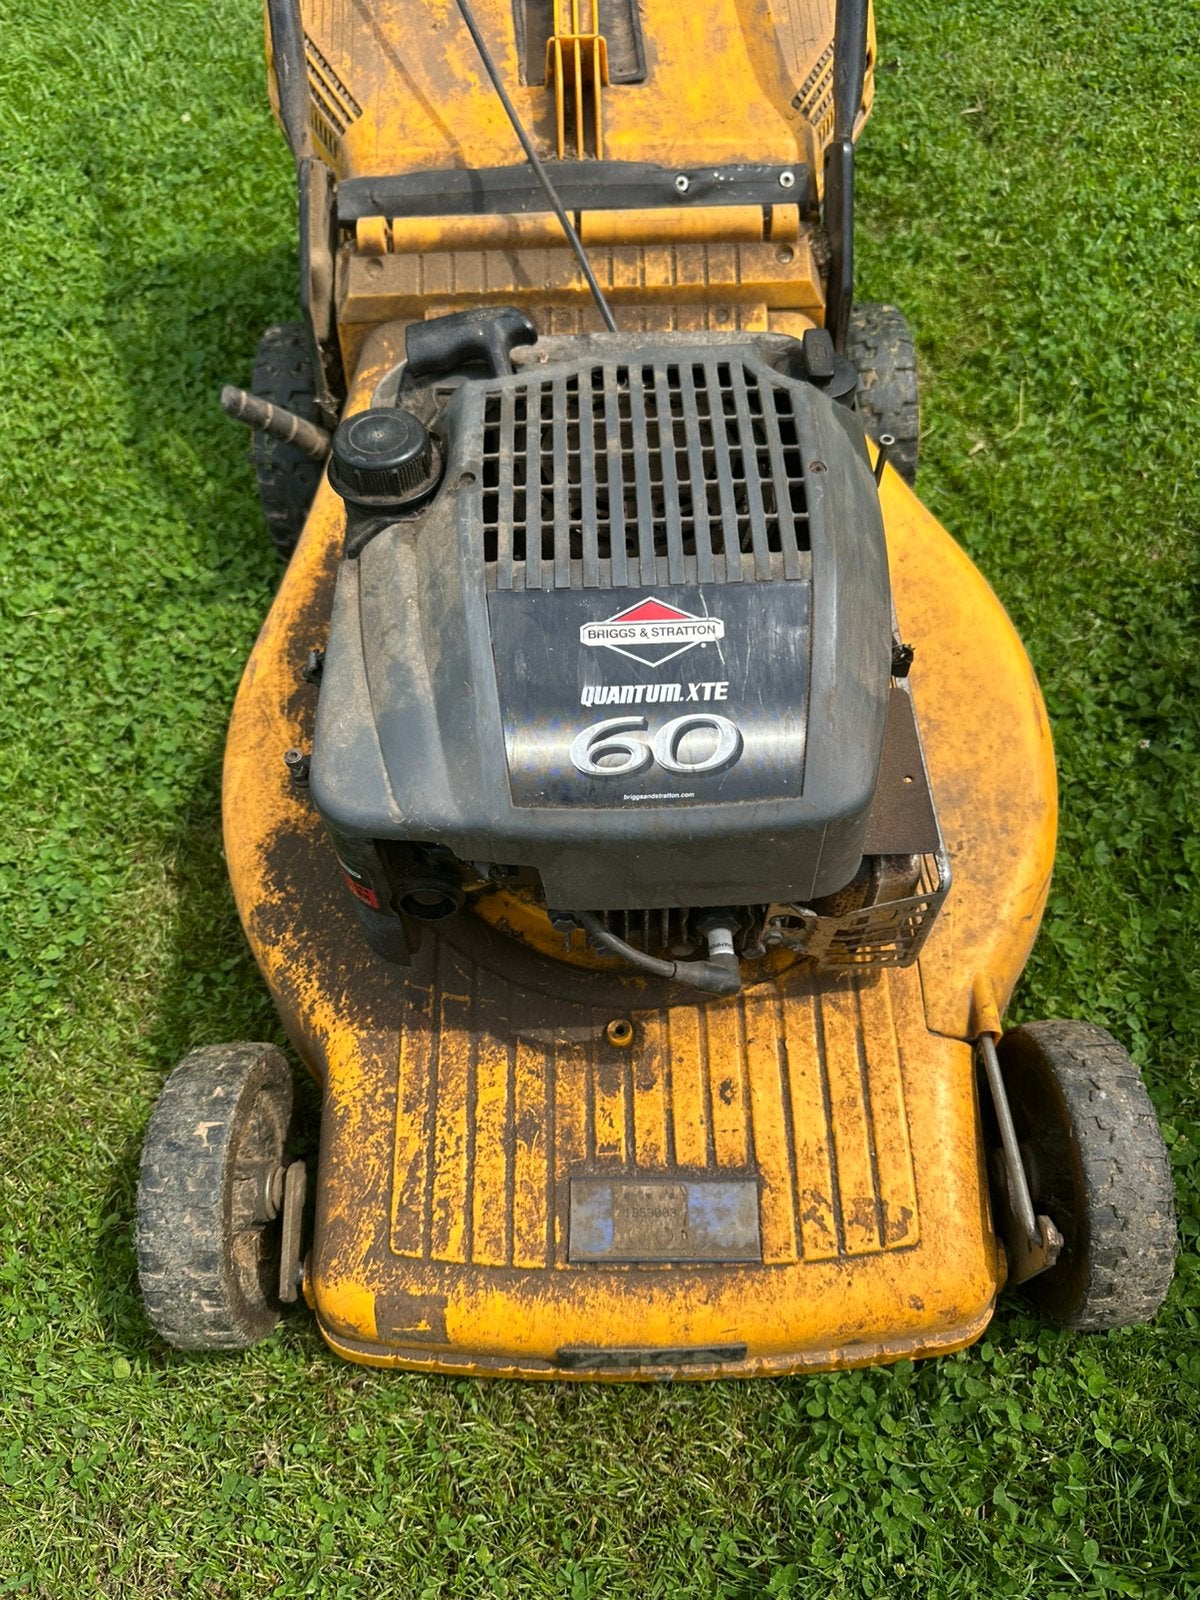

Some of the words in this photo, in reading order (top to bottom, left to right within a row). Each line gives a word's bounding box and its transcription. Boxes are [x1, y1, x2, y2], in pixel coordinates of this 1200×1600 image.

[587, 627, 637, 640] BRIGGS
[640, 627, 650, 639] &
[651, 624, 717, 638] STRATTON
[569, 713, 743, 776] 60
[623, 791, 695, 801] briggsandstratton.com
